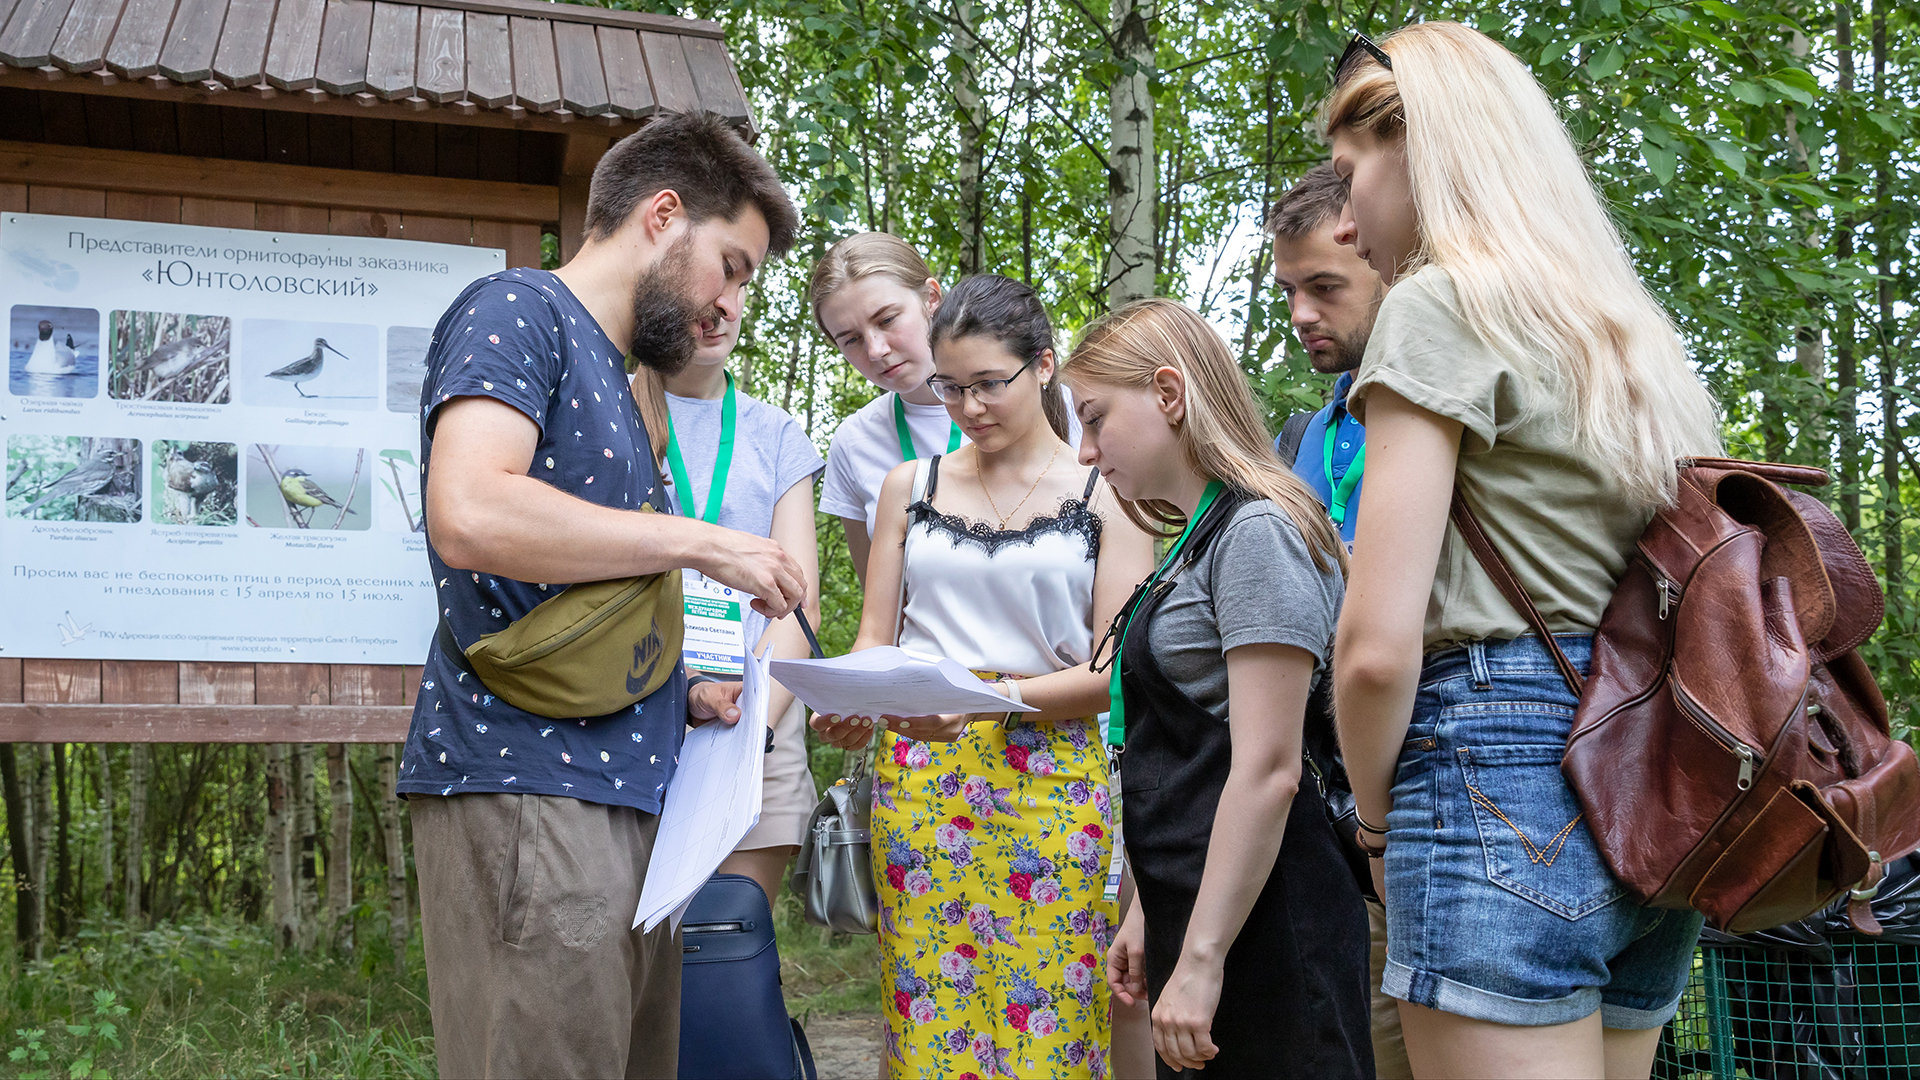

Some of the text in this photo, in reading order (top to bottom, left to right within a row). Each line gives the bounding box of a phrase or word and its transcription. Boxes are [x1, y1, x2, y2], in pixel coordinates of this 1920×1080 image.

[69, 231, 449, 274] Представители орнитофауны заказника
[304, 410, 328, 418] Бекас
[303, 535, 347, 543] трясогузка
[402, 537, 425, 545] Белос
[14, 565, 434, 588] Просим вас не беспокоить птиц в период весенних ми
[104, 586, 403, 601] и гнездования с 15 апреля по 15 июля.
[709, 626, 735, 636] Светлана
[632, 613, 664, 671] NIK
[696, 651, 733, 662] УЧАСТНИК
